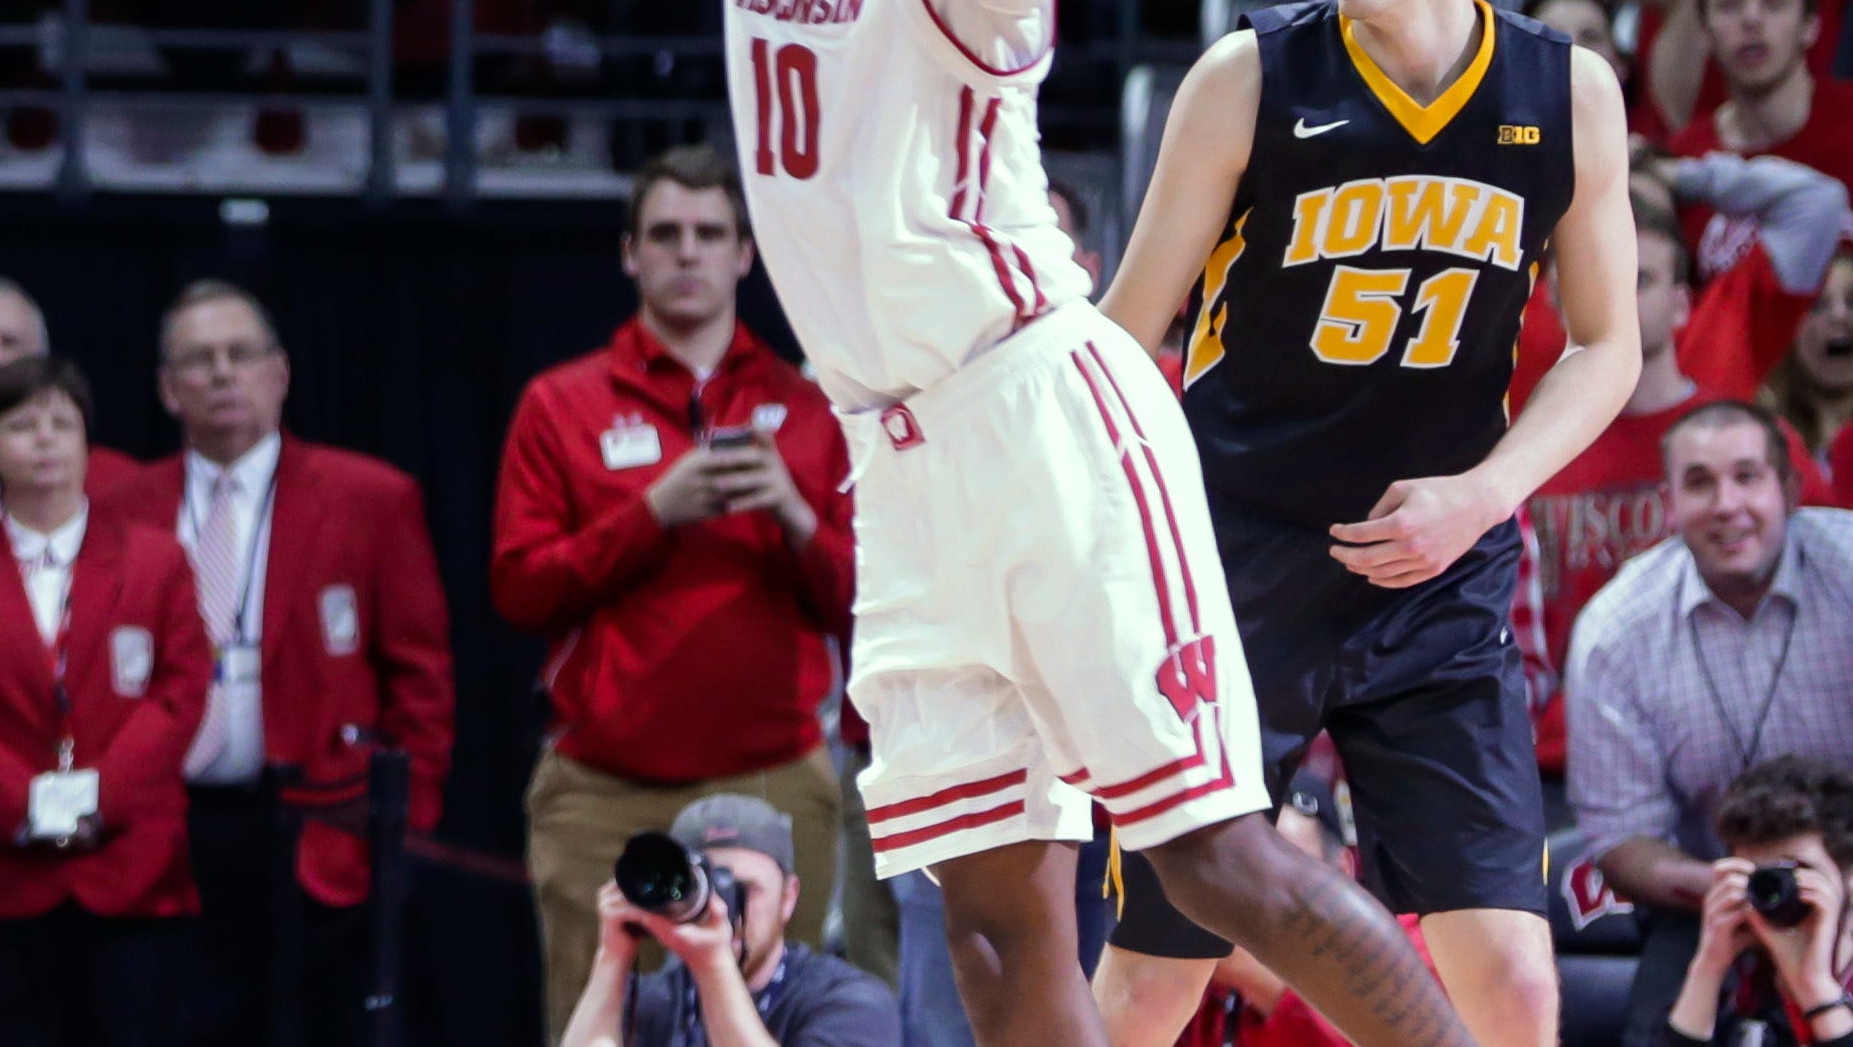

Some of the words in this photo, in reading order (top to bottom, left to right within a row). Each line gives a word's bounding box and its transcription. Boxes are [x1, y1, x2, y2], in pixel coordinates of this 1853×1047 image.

[751, 36, 821, 180] 10
[1282, 174, 1524, 271] IOWA
[1309, 265, 1480, 369] 51
[1154, 635, 1217, 723] W
